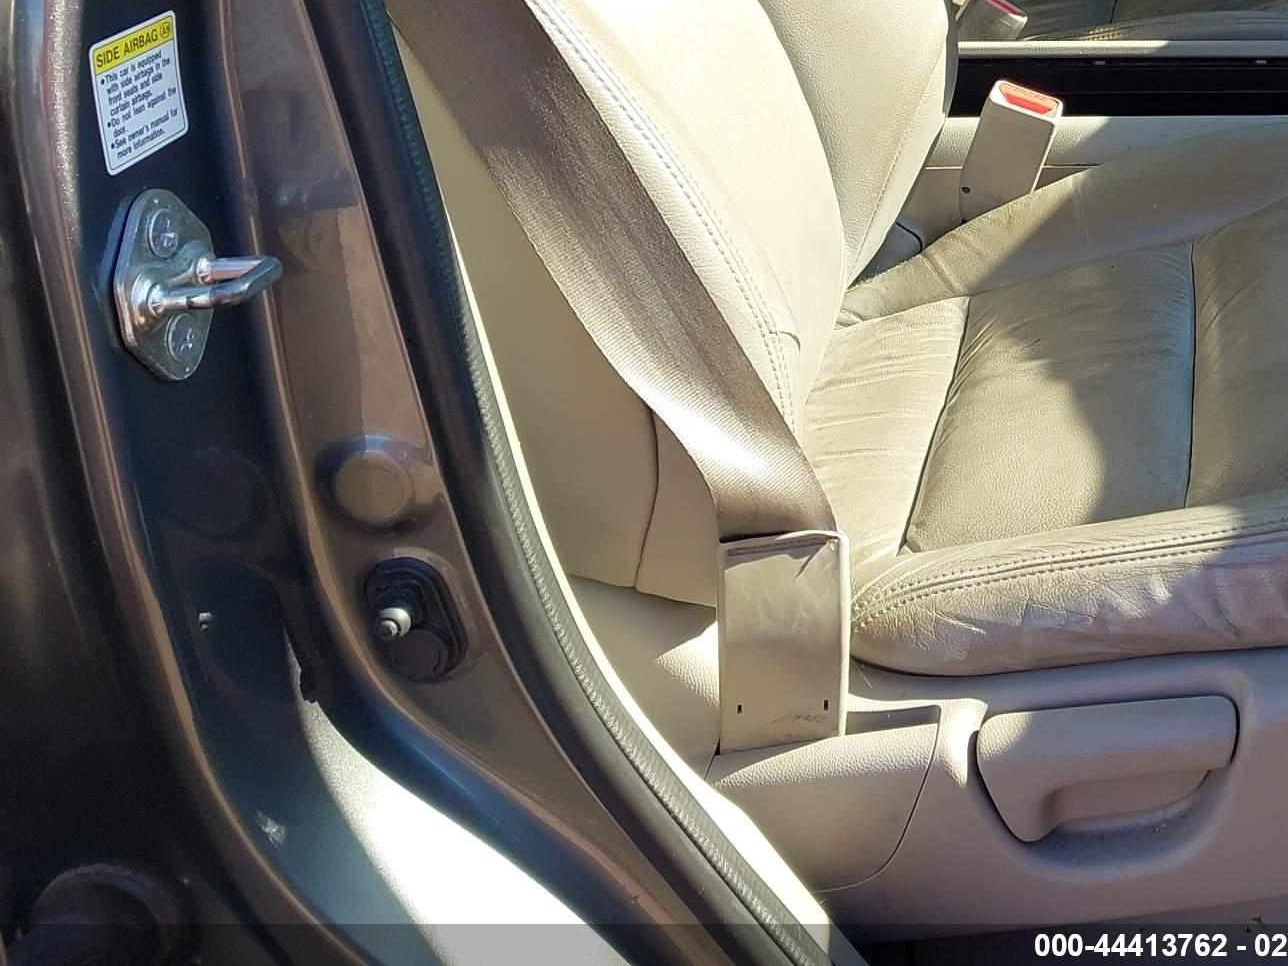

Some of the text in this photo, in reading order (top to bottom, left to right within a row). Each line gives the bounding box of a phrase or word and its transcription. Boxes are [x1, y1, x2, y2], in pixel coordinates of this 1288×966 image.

[96, 46, 120, 67] SIDE
[124, 29, 158, 56] AIRBAG
[105, 73, 118, 83] This
[120, 68, 129, 77] car
[138, 50, 162, 68] equipped
[107, 83, 119, 94] with
[120, 76, 132, 87] side
[134, 65, 154, 81] airbags
[162, 57, 170, 67] the
[108, 73, 162, 106] front seats and side
[110, 101, 130, 116] curtain
[111, 87, 176, 126] Do not lean against the
[113, 128, 128, 138] door.
[115, 138, 126, 148] See
[128, 124, 149, 143] owner's
[151, 111, 169, 130] manual
[117, 146, 132, 159] more
